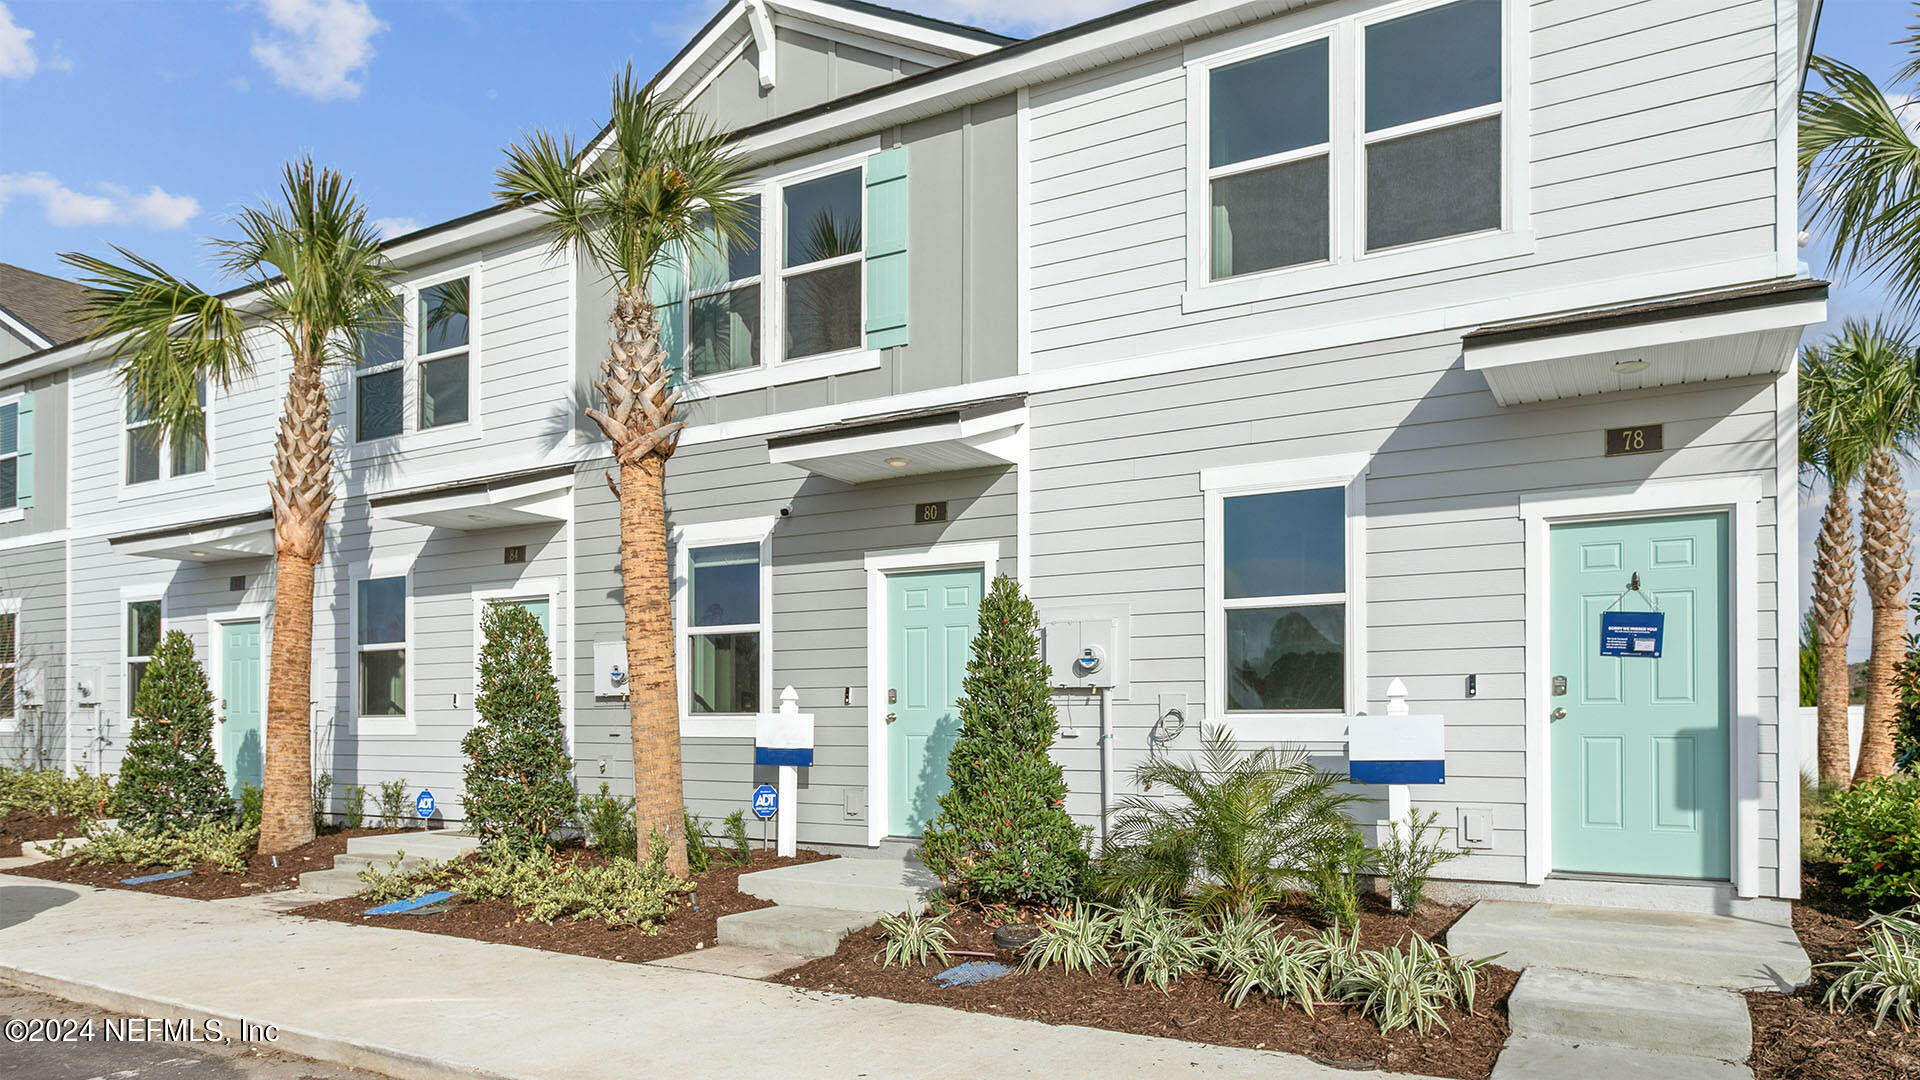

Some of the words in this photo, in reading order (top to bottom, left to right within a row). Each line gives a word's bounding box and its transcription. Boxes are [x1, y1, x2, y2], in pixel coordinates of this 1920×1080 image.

[1623, 430, 1644, 450] 78
[924, 505, 937, 520] 80
[510, 549, 519, 561] 84
[418, 797, 433, 808] ADT
[755, 794, 776, 806] ADT
